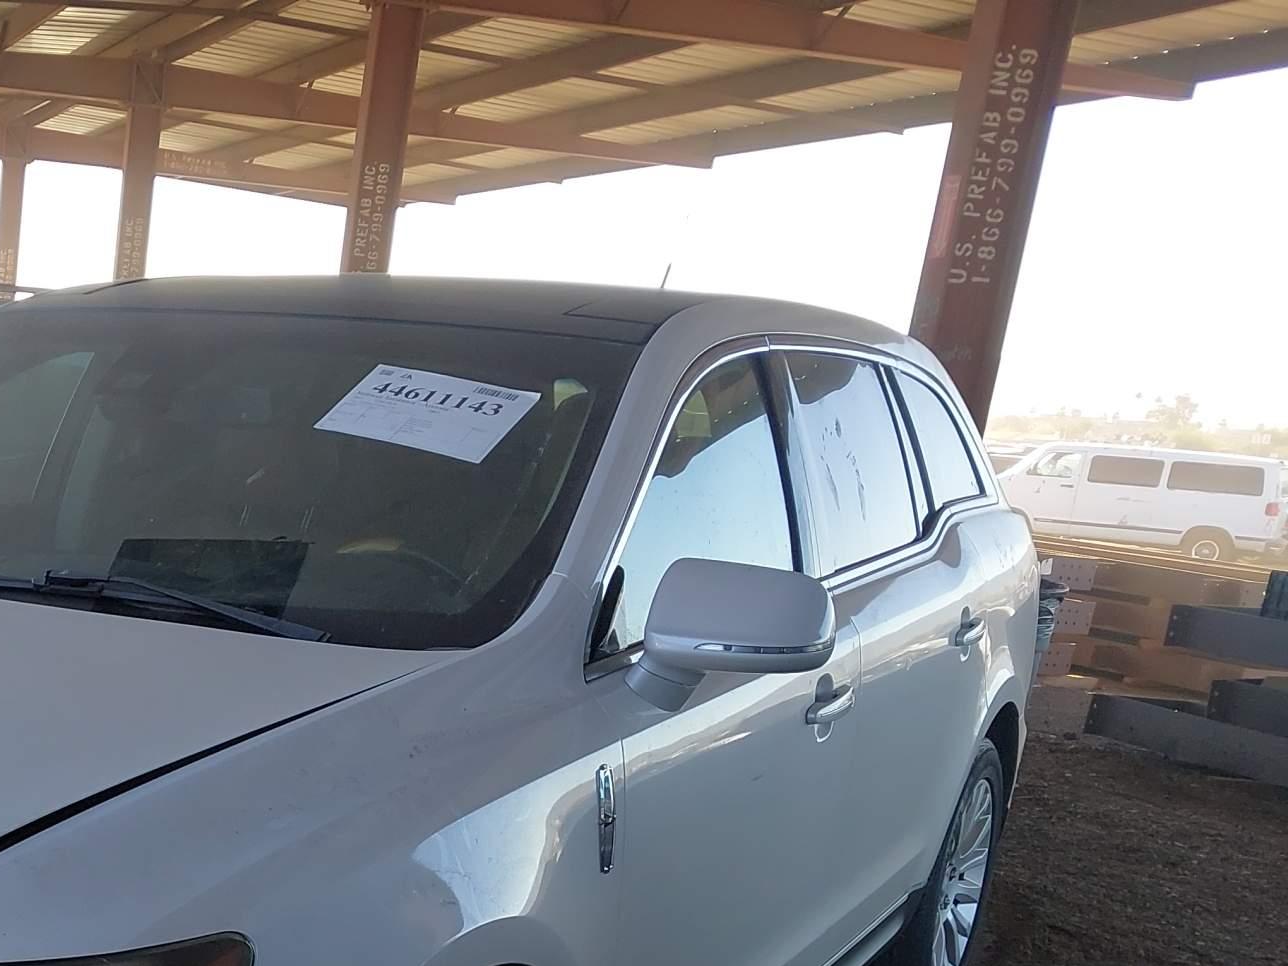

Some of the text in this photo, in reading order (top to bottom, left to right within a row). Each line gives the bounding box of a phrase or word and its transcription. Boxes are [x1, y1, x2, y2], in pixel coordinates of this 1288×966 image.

[367, 163, 391, 271] 66-799-0969
[948, 44, 1016, 284] U.S. PREFAB INC.
[971, 48, 1039, 284] 1-866-799-0969
[353, 198, 373, 257] PREFAB
[372, 381, 504, 417] 44611143
